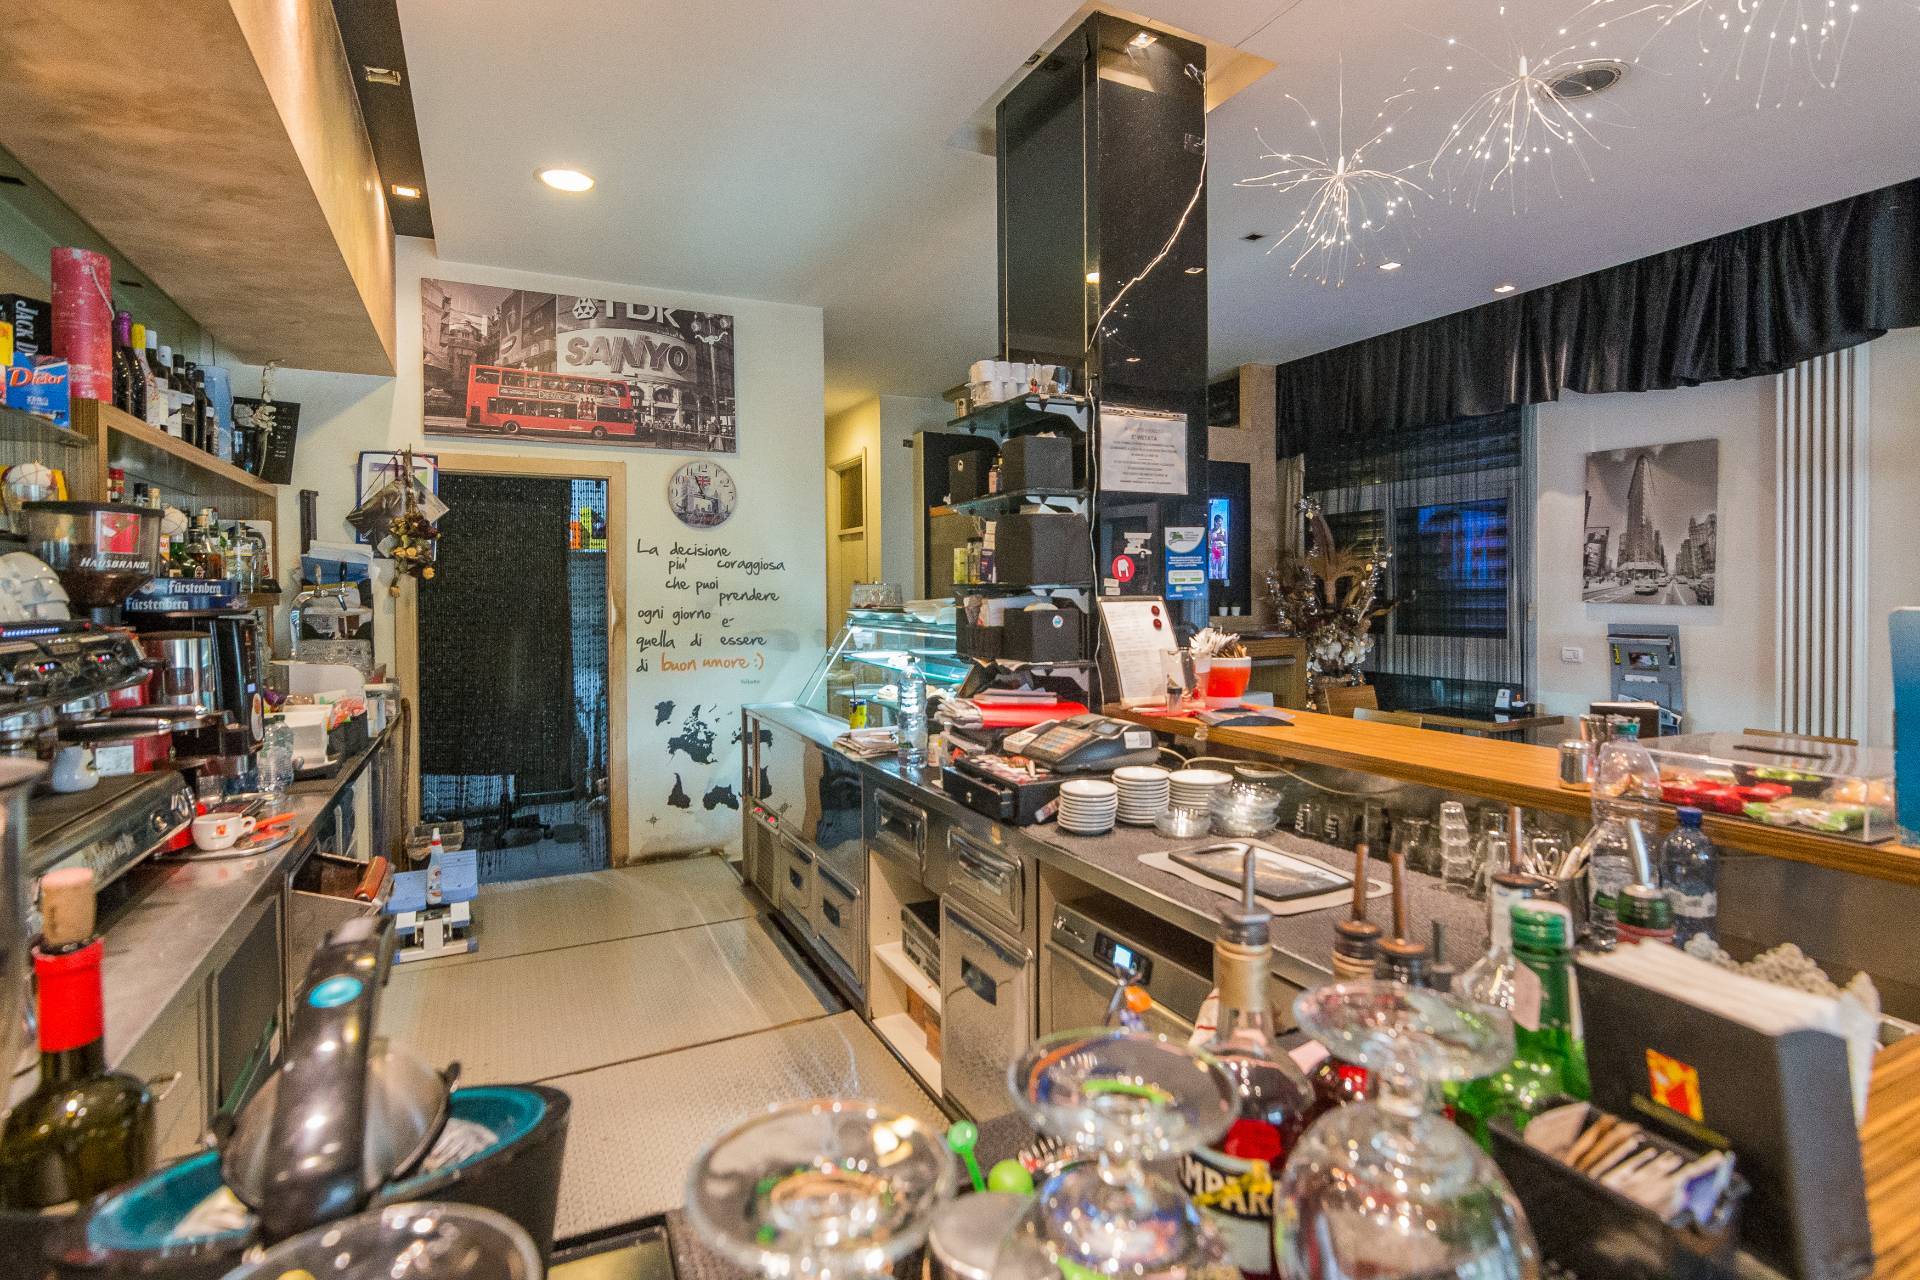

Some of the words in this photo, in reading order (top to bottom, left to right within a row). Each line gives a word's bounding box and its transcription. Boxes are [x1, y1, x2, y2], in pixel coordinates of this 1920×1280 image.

[15, 300, 39, 340] JACK
[565, 334, 689, 373] SANYO
[637, 539, 659, 555] La
[670, 542, 730, 557] decisione
[79, 557, 150, 570] HAUSBRANDT
[717, 558, 785, 575] coraggiosa
[168, 580, 222, 595] Fürstenberg
[665, 577, 690, 590] che
[696, 577, 719, 595] puoi
[719, 588, 779, 606] prendere
[125, 598, 190, 612] Fürstenberg
[638, 606, 664, 624] ogni
[672, 607, 711, 625] giorno
[636, 630, 676, 652] quella
[690, 633, 702, 647] di
[720, 635, 767, 646] essere
[636, 659, 648, 673] di
[661, 652, 697, 672] buon
[702, 657, 750, 669] umore
